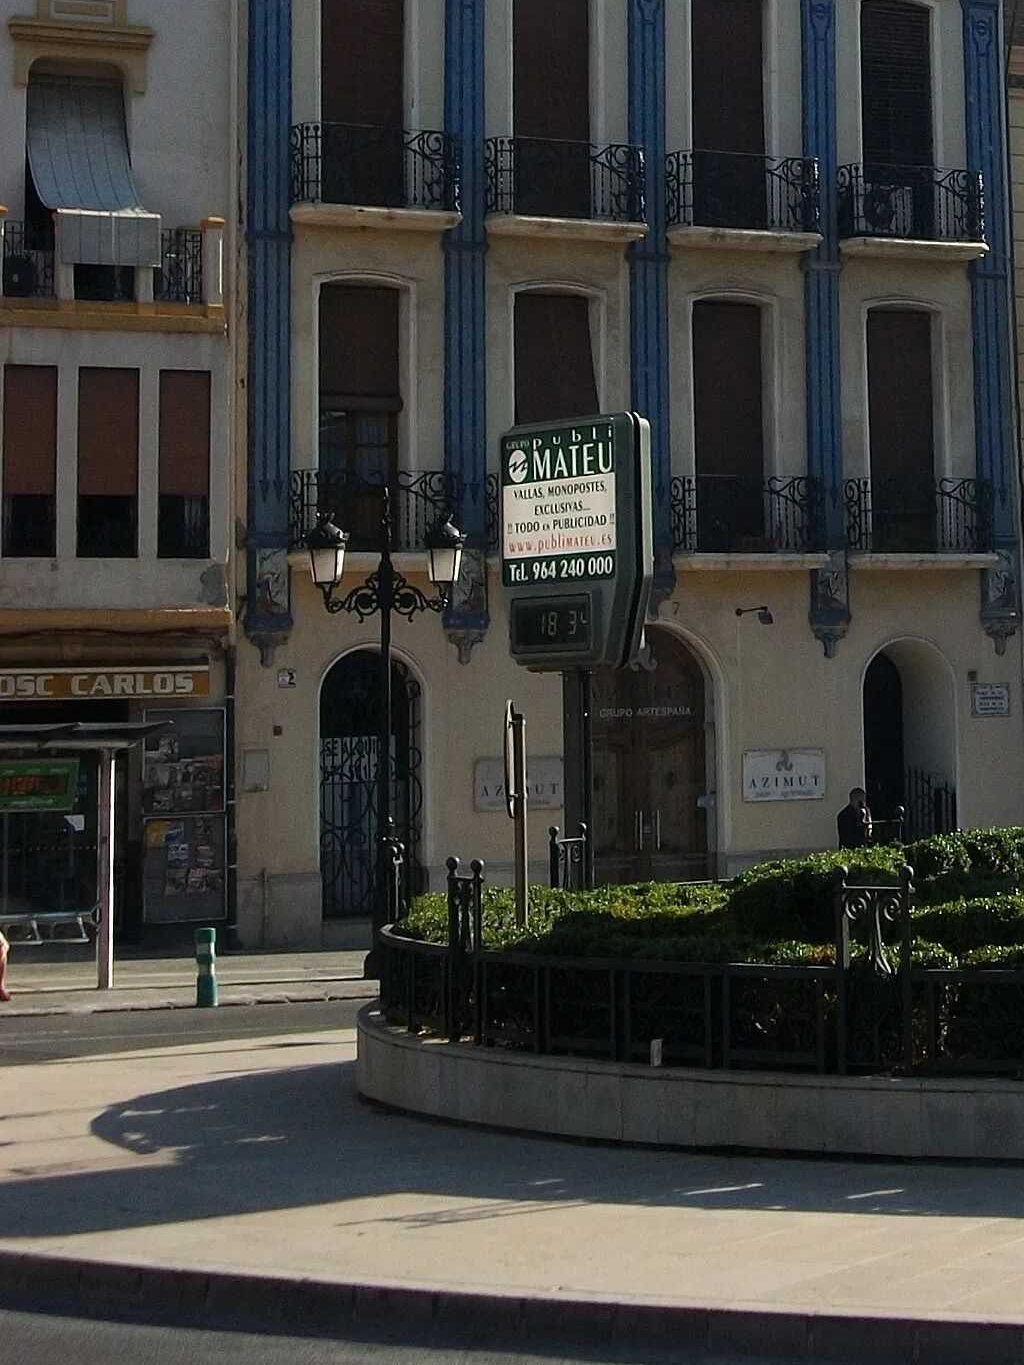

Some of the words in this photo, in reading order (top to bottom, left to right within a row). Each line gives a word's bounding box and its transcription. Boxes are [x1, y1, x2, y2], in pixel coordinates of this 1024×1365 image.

[533, 441, 612, 481] MATEU
[547, 480, 607, 497] MONOPOSTES,
[515, 521, 540, 534] TODO
[553, 514, 607, 530] PUBLICIDAD
[533, 561, 556, 580] 964
[560, 558, 585, 578] 240
[588, 555, 613, 576] 000
[70, 673, 194, 696] CARLOS
[600, 708, 633, 718] GRUPO
[481, 783, 559, 797] AZUT
[749, 775, 820, 789] AZIMUT
